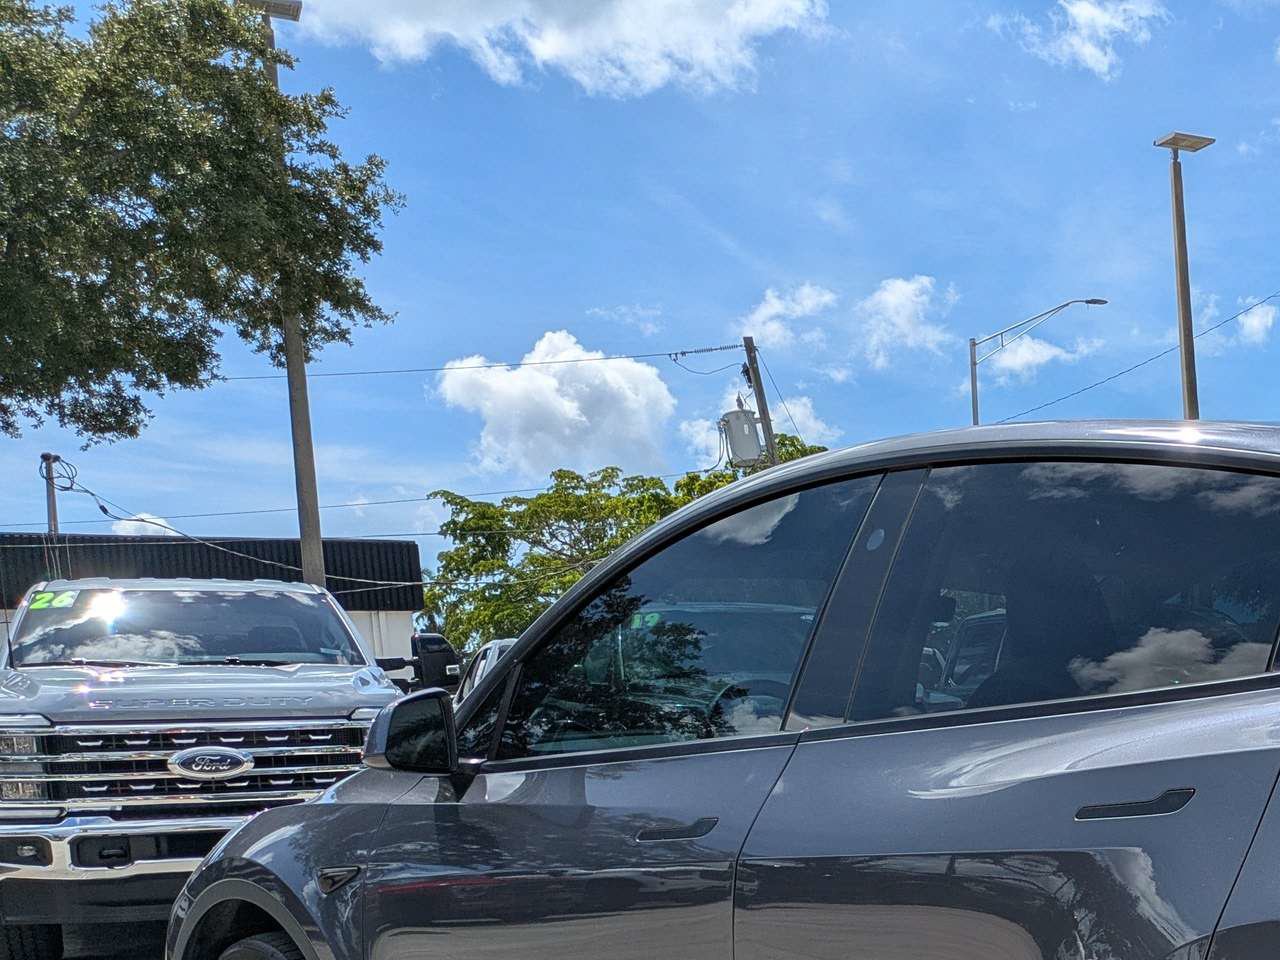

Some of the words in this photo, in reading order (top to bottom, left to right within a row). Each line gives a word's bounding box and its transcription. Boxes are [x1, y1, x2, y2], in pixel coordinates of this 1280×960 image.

[29, 591, 77, 609] 26
[88, 697, 216, 710] SUPER
[222, 696, 313, 708] DUTY
[192, 755, 231, 772] Ford
